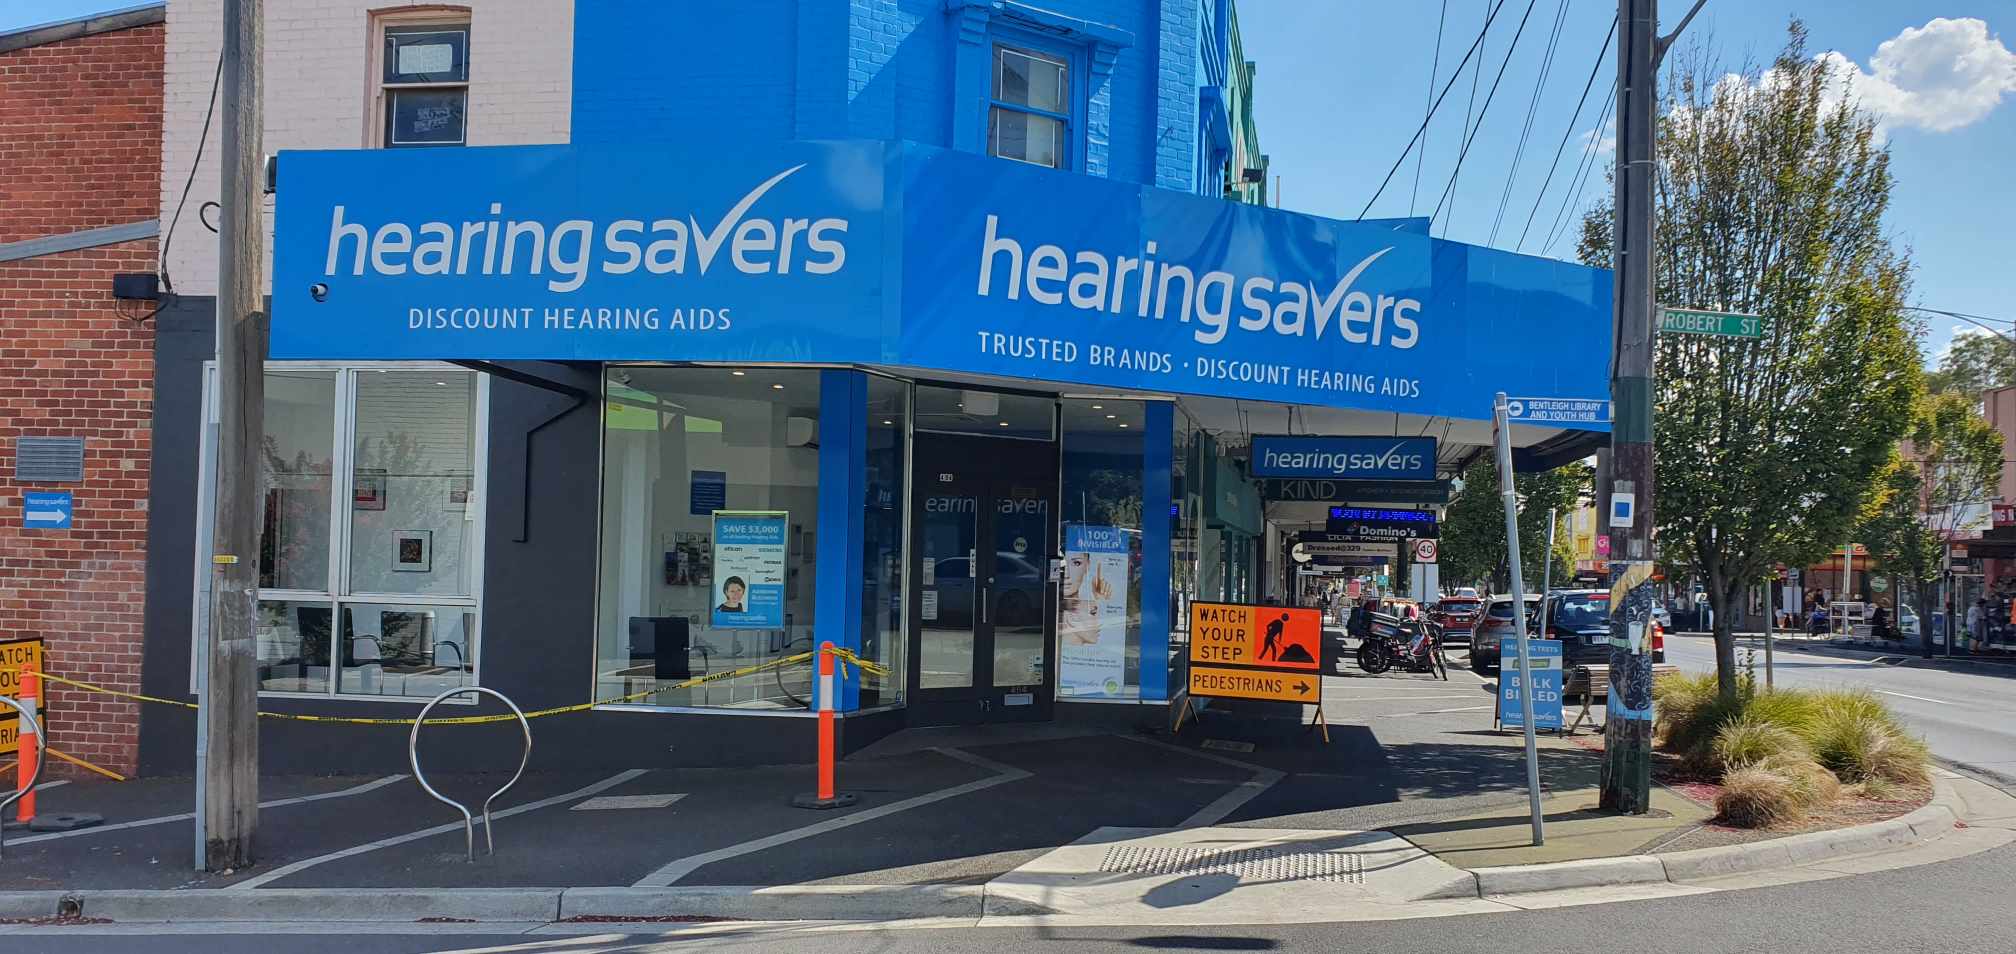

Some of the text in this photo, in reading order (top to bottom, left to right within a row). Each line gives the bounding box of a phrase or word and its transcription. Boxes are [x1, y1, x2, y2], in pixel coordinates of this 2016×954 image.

[408, 308, 731, 330] DISCOUNT HEARING AIDS
[1665, 313, 1758, 335] ROBERT ST
[978, 331, 1420, 398] TRUSTED BRANDS DISCOUNT HEARING AIDS
[1529, 401, 1602, 411] BENTLEIGH LIBRARY
[1530, 411, 1596, 420] AND YOUTH HUB
[1281, 481, 1336, 499] KIND
[1359, 525, 1417, 537] Domino's
[1420, 545, 1432, 554] 40
[1200, 608, 1247, 624] WATCH
[1200, 627, 1246, 642] YOUR
[0, 647, 33, 664] ATCH
[1201, 645, 1243, 660] STEP
[1193, 674, 1282, 693] PEDESTRIANS
[1511, 677, 1551, 689] BLK
[1505, 688, 1557, 702] BIED
